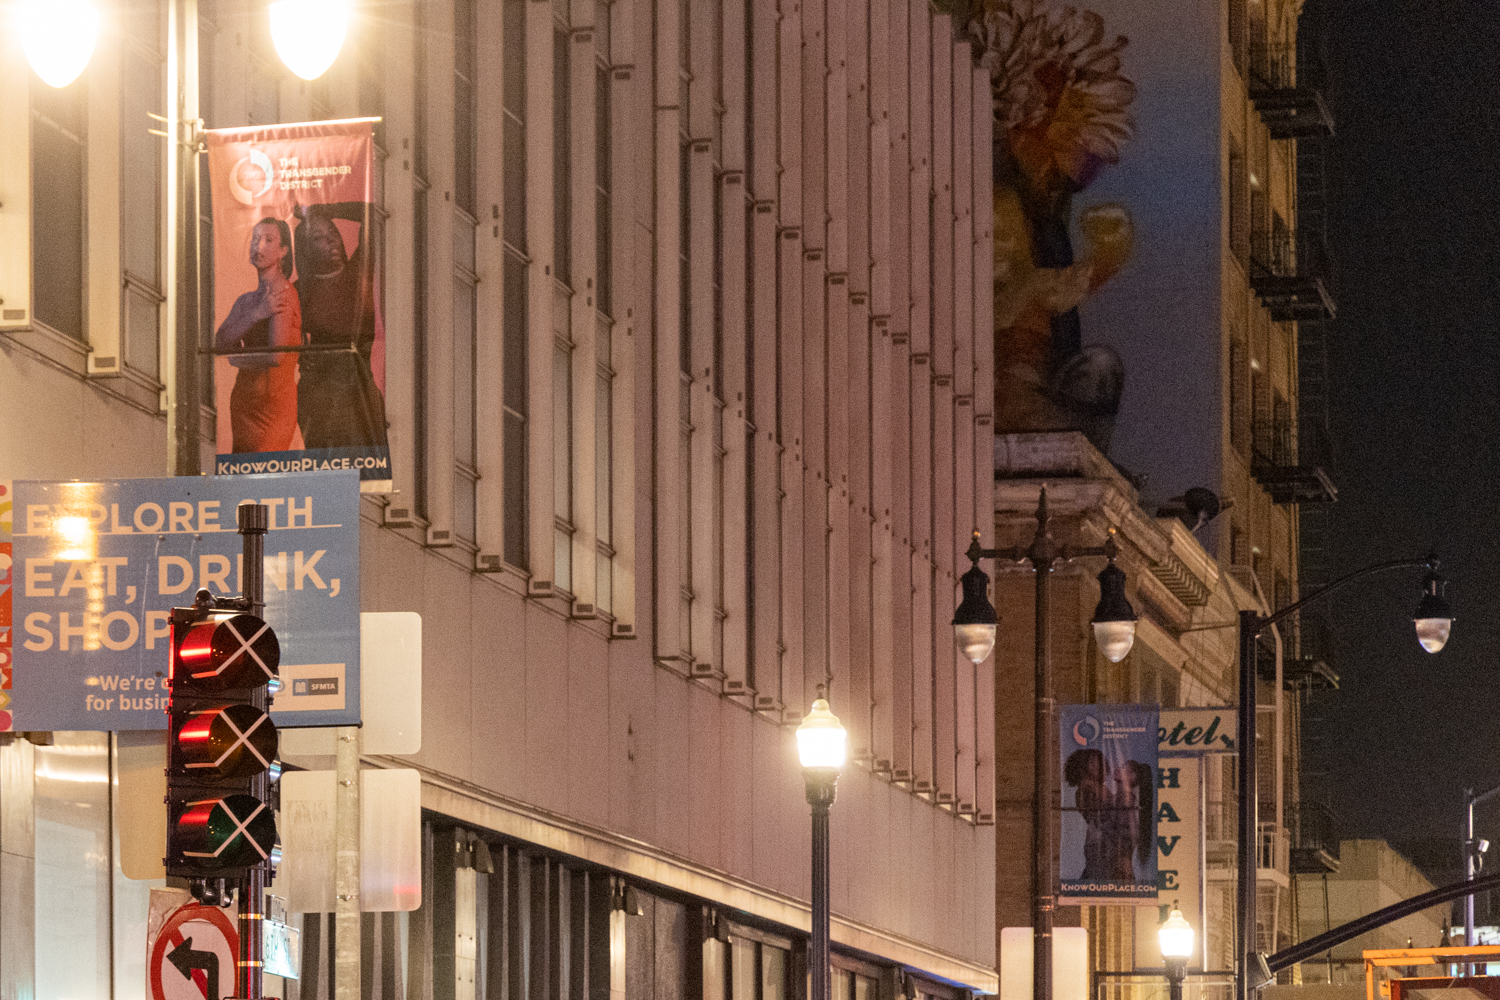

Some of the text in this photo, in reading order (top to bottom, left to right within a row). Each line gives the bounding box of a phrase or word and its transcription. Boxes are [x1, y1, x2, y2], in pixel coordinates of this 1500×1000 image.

[279, 157, 298, 167] THE
[279, 165, 352, 179] TRANSGENDER
[279, 179, 323, 190] DISTRICT
[26, 500, 222, 536] EPLORE
[24, 549, 342, 605] EAT, DRINK,
[99, 675, 156, 691] We're
[310, 683, 336, 691] SFMTA
[85, 693, 170, 711] for busin
[1158, 715, 1221, 747] otel
